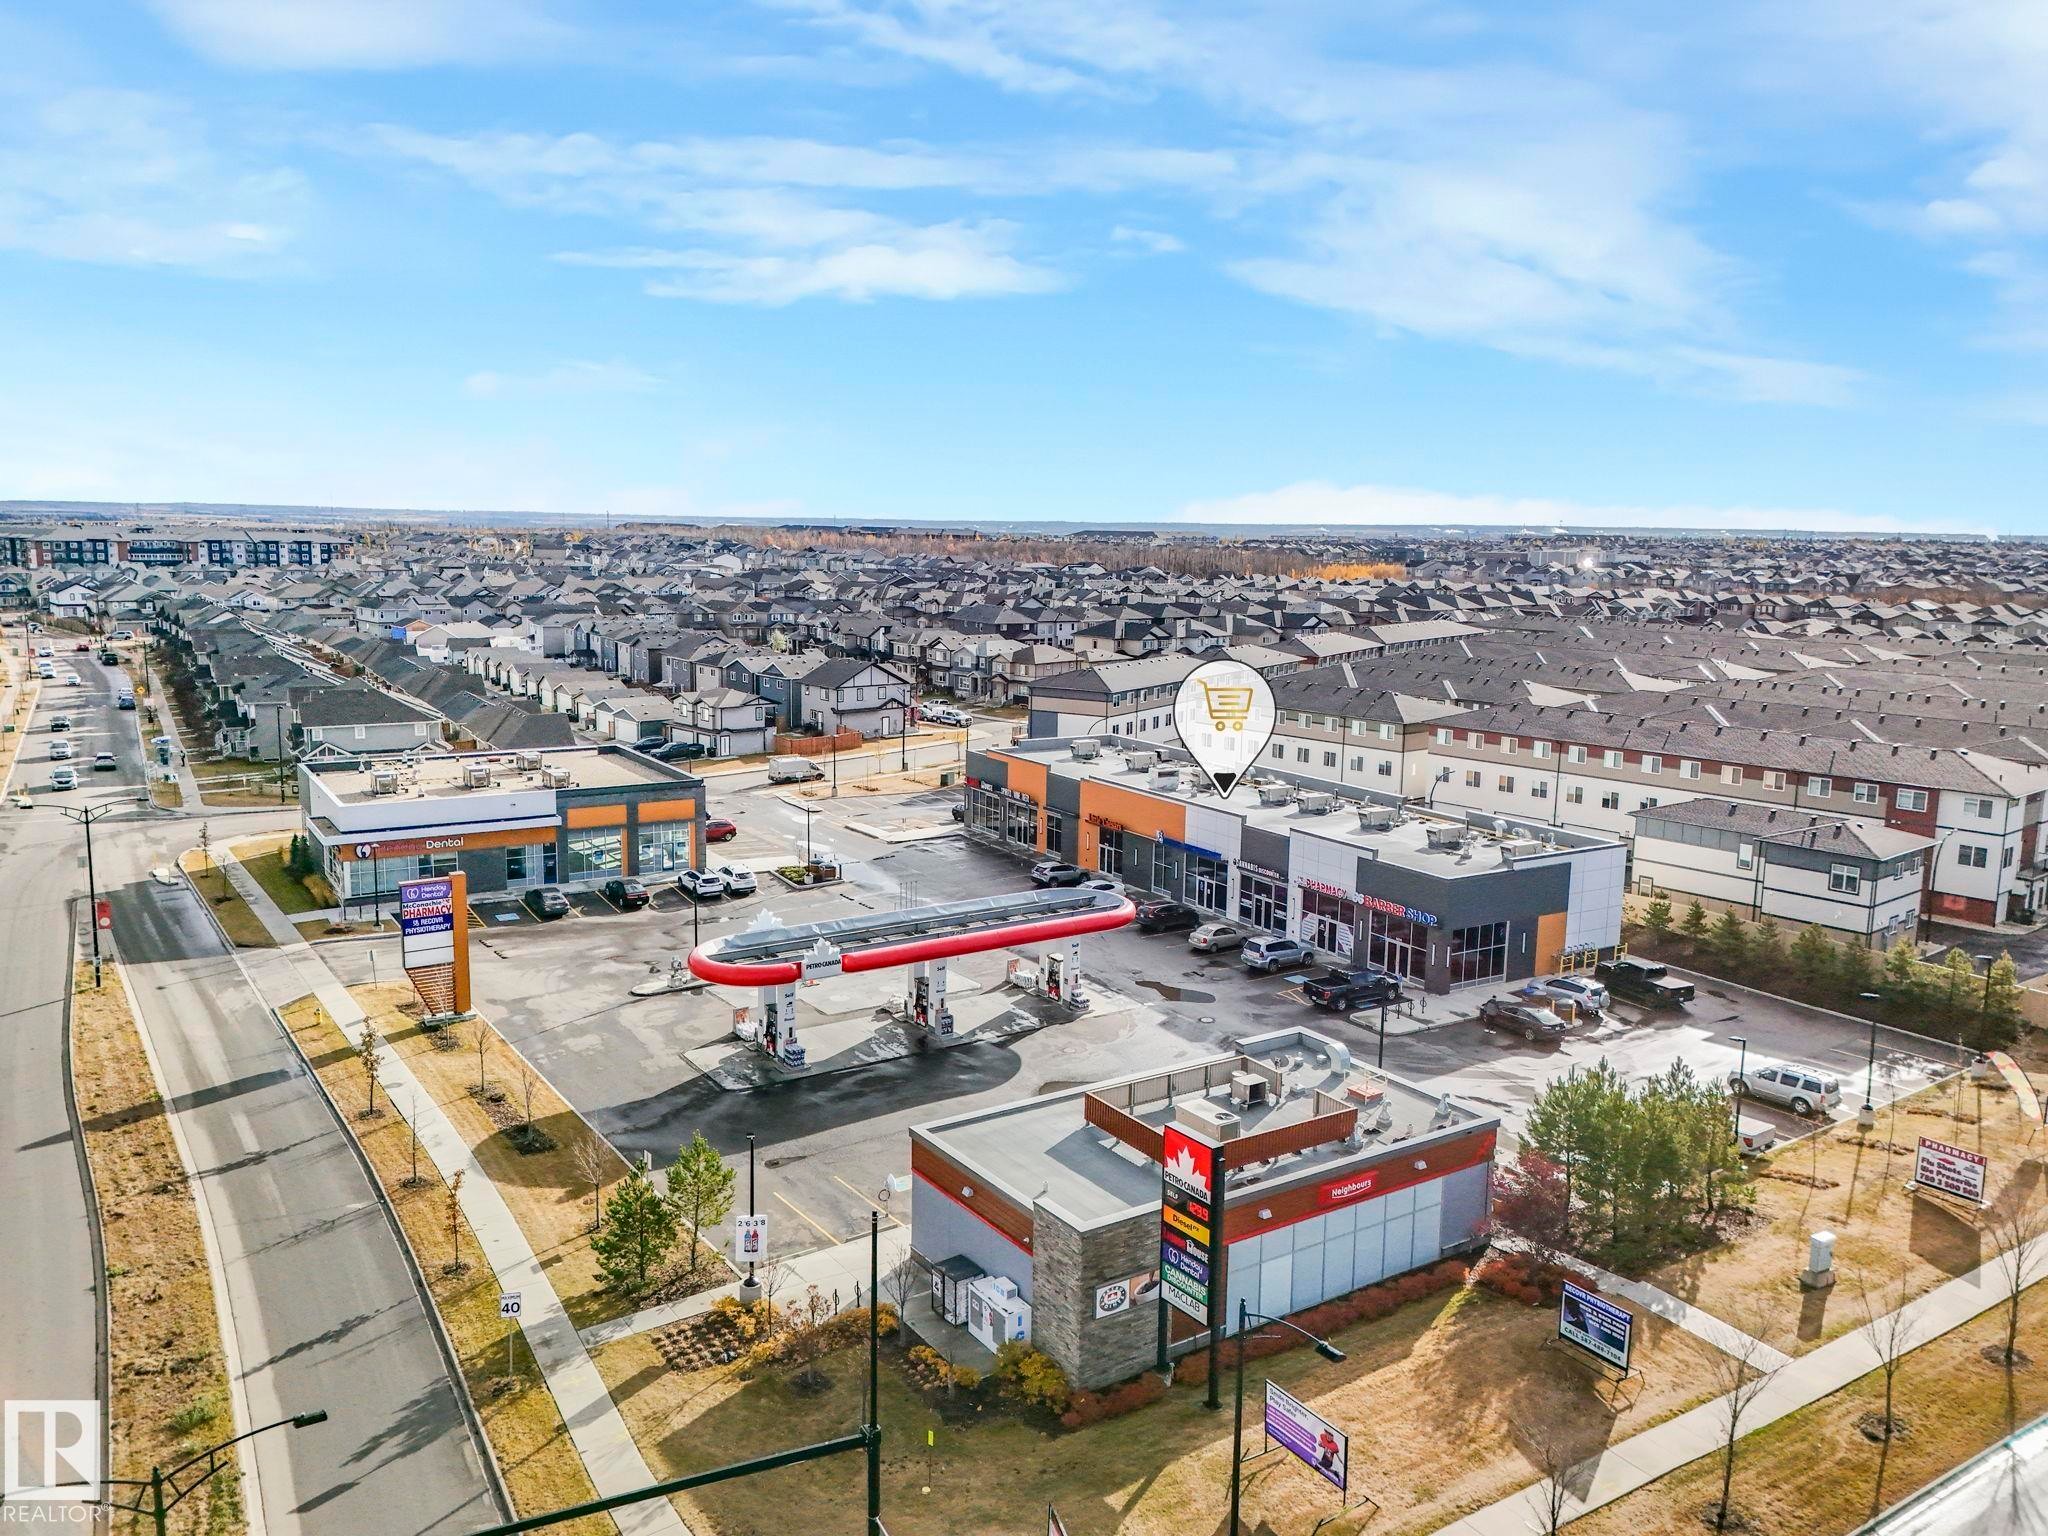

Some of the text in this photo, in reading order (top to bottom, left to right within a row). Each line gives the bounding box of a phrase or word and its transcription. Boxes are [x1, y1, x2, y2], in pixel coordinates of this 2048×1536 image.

[426, 837, 464, 849] Dental
[1306, 878, 1346, 899] PHARMACY
[404, 905, 452, 918] PHARMACY
[1364, 894, 1406, 918] BARBER
[1406, 908, 1437, 926] SHOP
[406, 924, 450, 934] PHYSIOTHERAPY
[1925, 1140, 1980, 1162] PHARMACY
[1922, 1157, 1934, 1166] Flu
[1936, 1162, 1962, 1175] Shots
[1936, 1170, 1978, 1189] Prescribe
[1332, 1180, 1372, 1197] Neighbours
[1172, 1214, 1192, 1231] Diesel
[1180, 1262, 1200, 1279] Dental
[1164, 1265, 1206, 1296] CANNABIS
[1168, 1273, 1204, 1300] DISCOUNTER
[1168, 1286, 1200, 1312] MACLAB
[502, 1302, 520, 1314] 40
[1564, 1326, 1578, 1338] CALL
